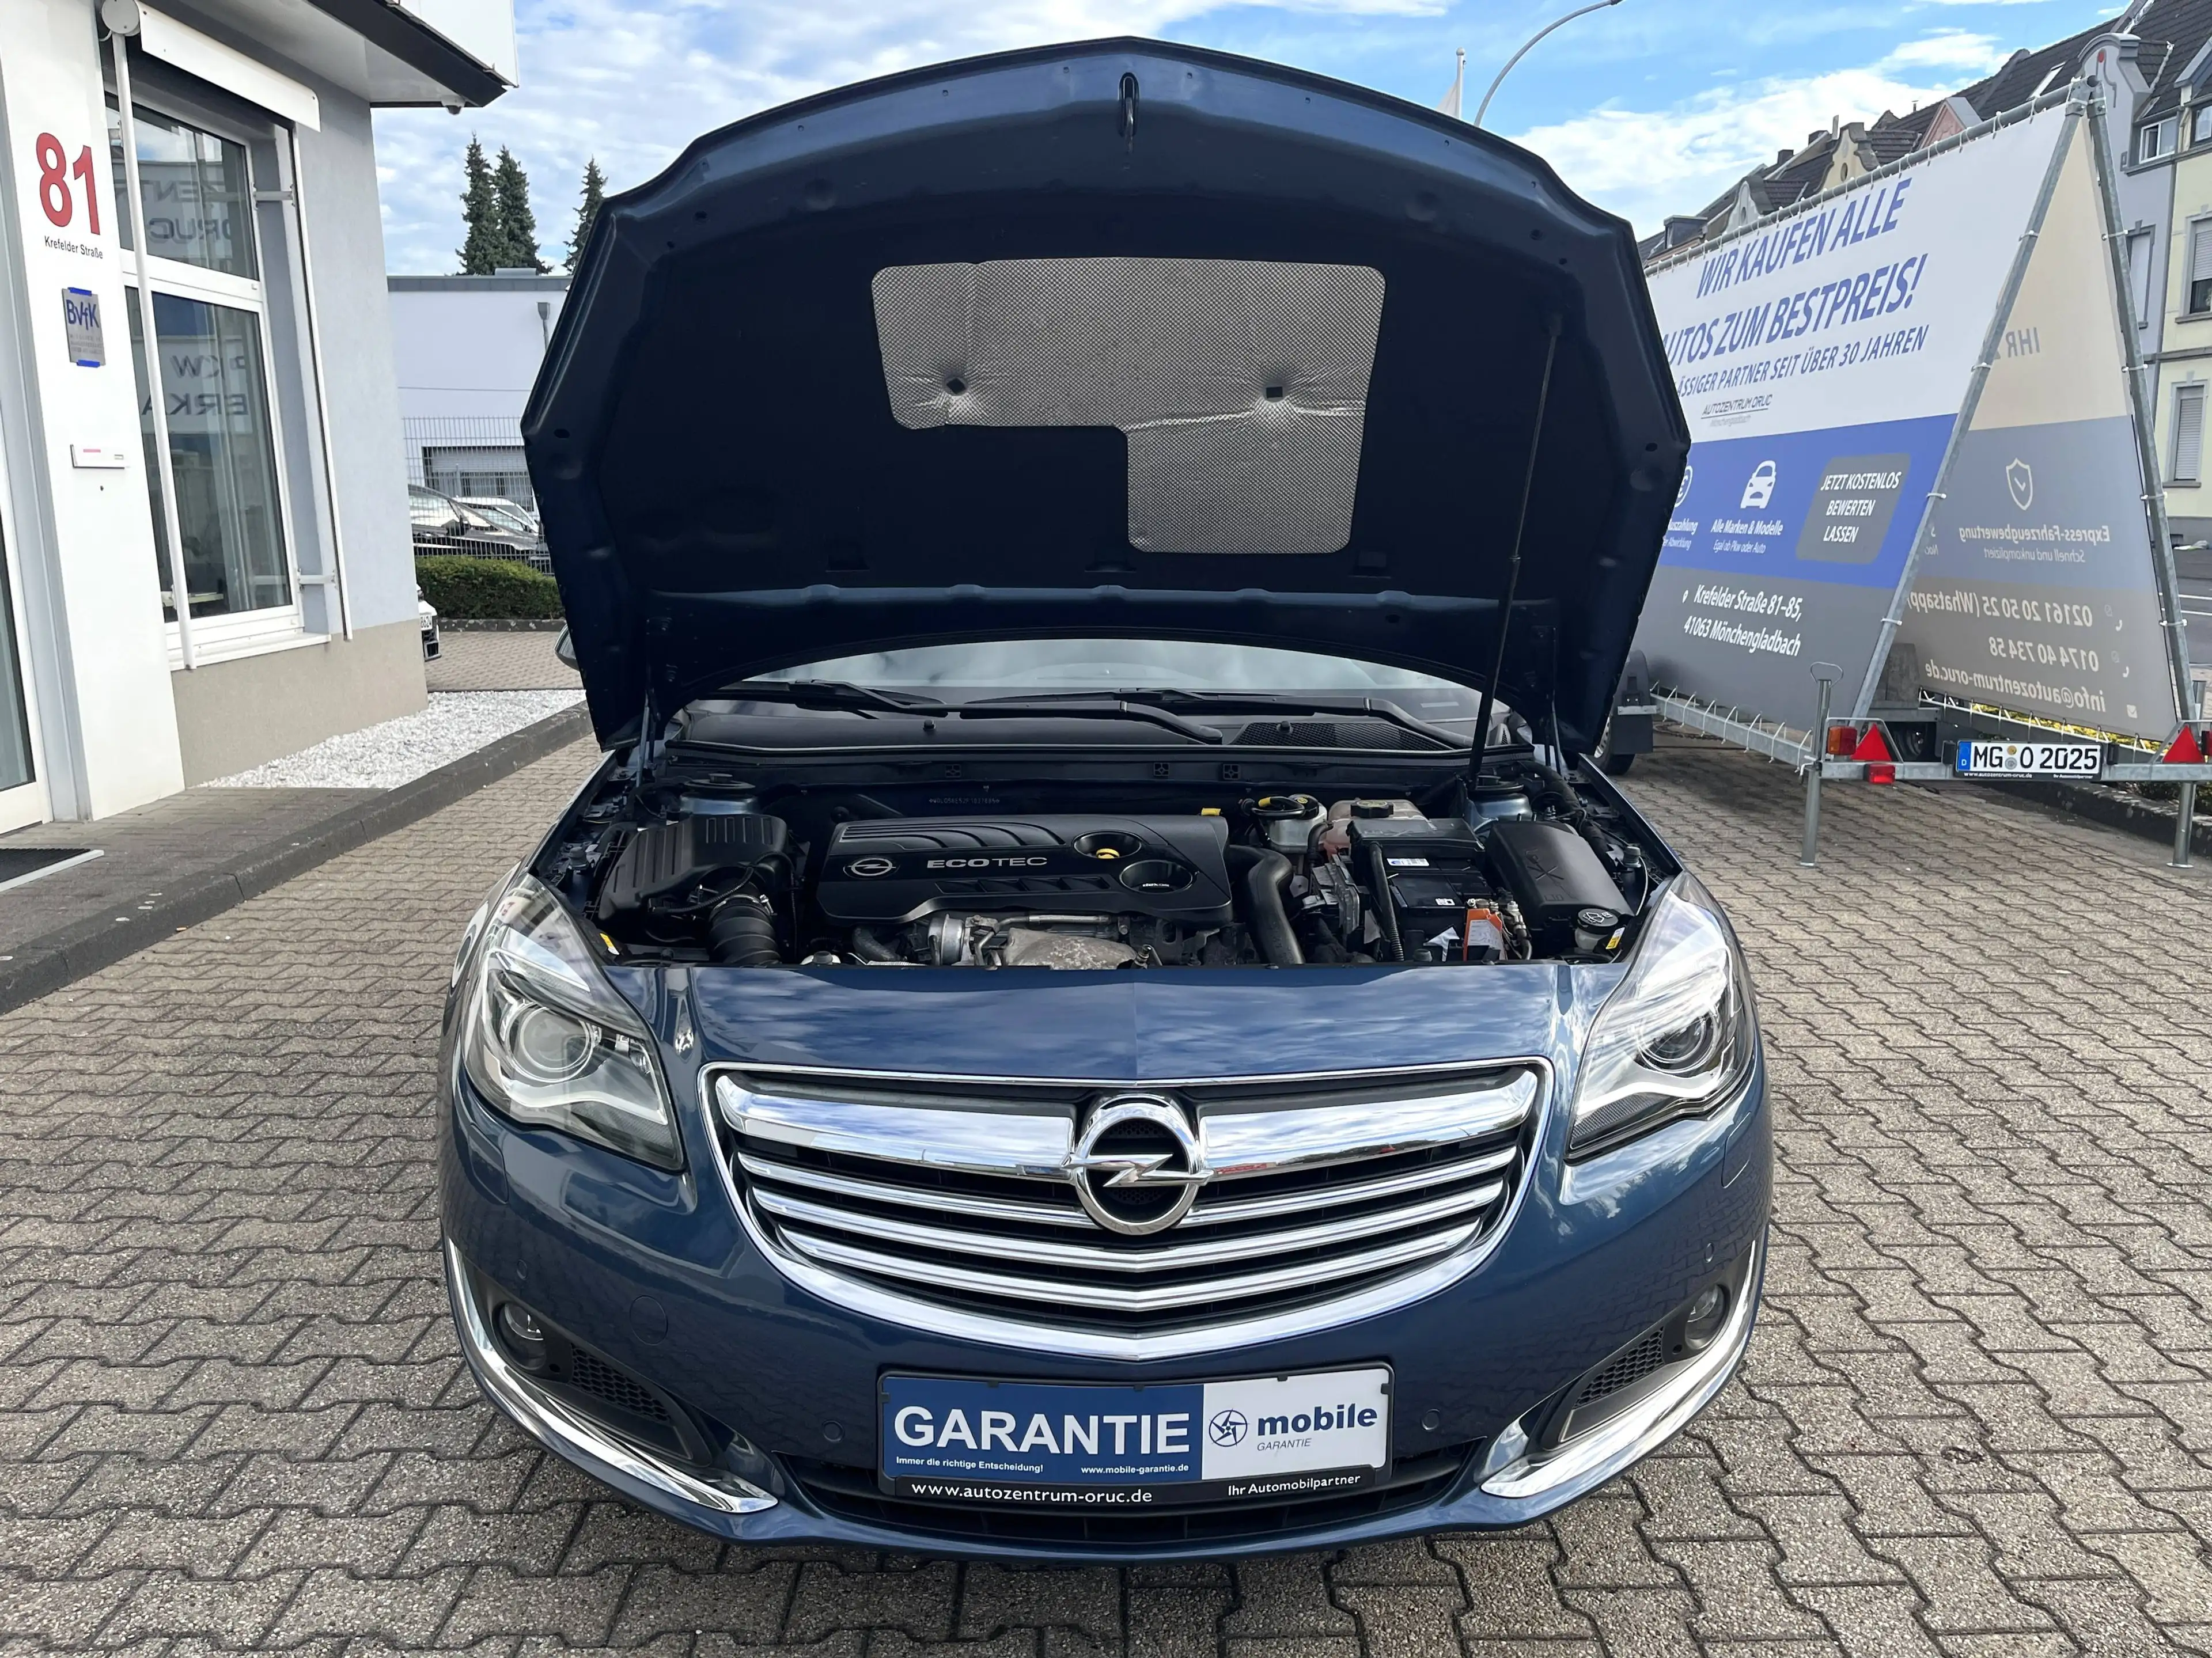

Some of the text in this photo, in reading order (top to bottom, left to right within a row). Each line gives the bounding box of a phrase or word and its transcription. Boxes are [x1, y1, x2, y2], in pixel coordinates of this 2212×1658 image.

[36, 132, 100, 235] 81
[44, 235, 103, 259] Krefelder Straße
[1696, 177, 1912, 299] WIR KAUFEN ALLE
[66, 299, 100, 331] BVfK
[1714, 302, 1771, 356] ZUM
[1766, 253, 1929, 343] BESTPREIS!
[1677, 324, 1929, 397] ÄSSIGER PARTNER SEIT ÜBER 30 JAHREN
[1702, 394, 1773, 415] AUTOZENTRUM ORUC
[1820, 471, 1902, 491] JETZT KOSTENLOS
[1825, 499, 1876, 517] BEWERTEN
[1711, 519, 1784, 536] Alle Marken & Modelle
[1823, 525, 1859, 543] LASSEN
[1713, 540, 1725, 553] Egal
[1740, 542, 1753, 553] oder
[1752, 542, 1766, 554] Auto
[1694, 584, 1736, 609] Krefelder
[1734, 589, 1768, 614] Straße
[1684, 615, 1801, 657] 41063 Mönchengladbach
[1974, 746, 2003, 768] MG
[2040, 748, 2098, 770] 2025
[927, 856, 1048, 868] ECOTEC
[1257, 1403, 1378, 1436] mobile
[894, 1406, 1190, 1455] GARANTIE
[1257, 1438, 1312, 1451] GARANTIE
[896, 1456, 1043, 1473] Immer die richtige Entscheidung!
[1081, 1464, 1189, 1474] www.mobile-garantie.de
[911, 1483, 1153, 1503] www.autozentrum-oruc.de
[1228, 1475, 1361, 1496] Ihr Automobilpartner
